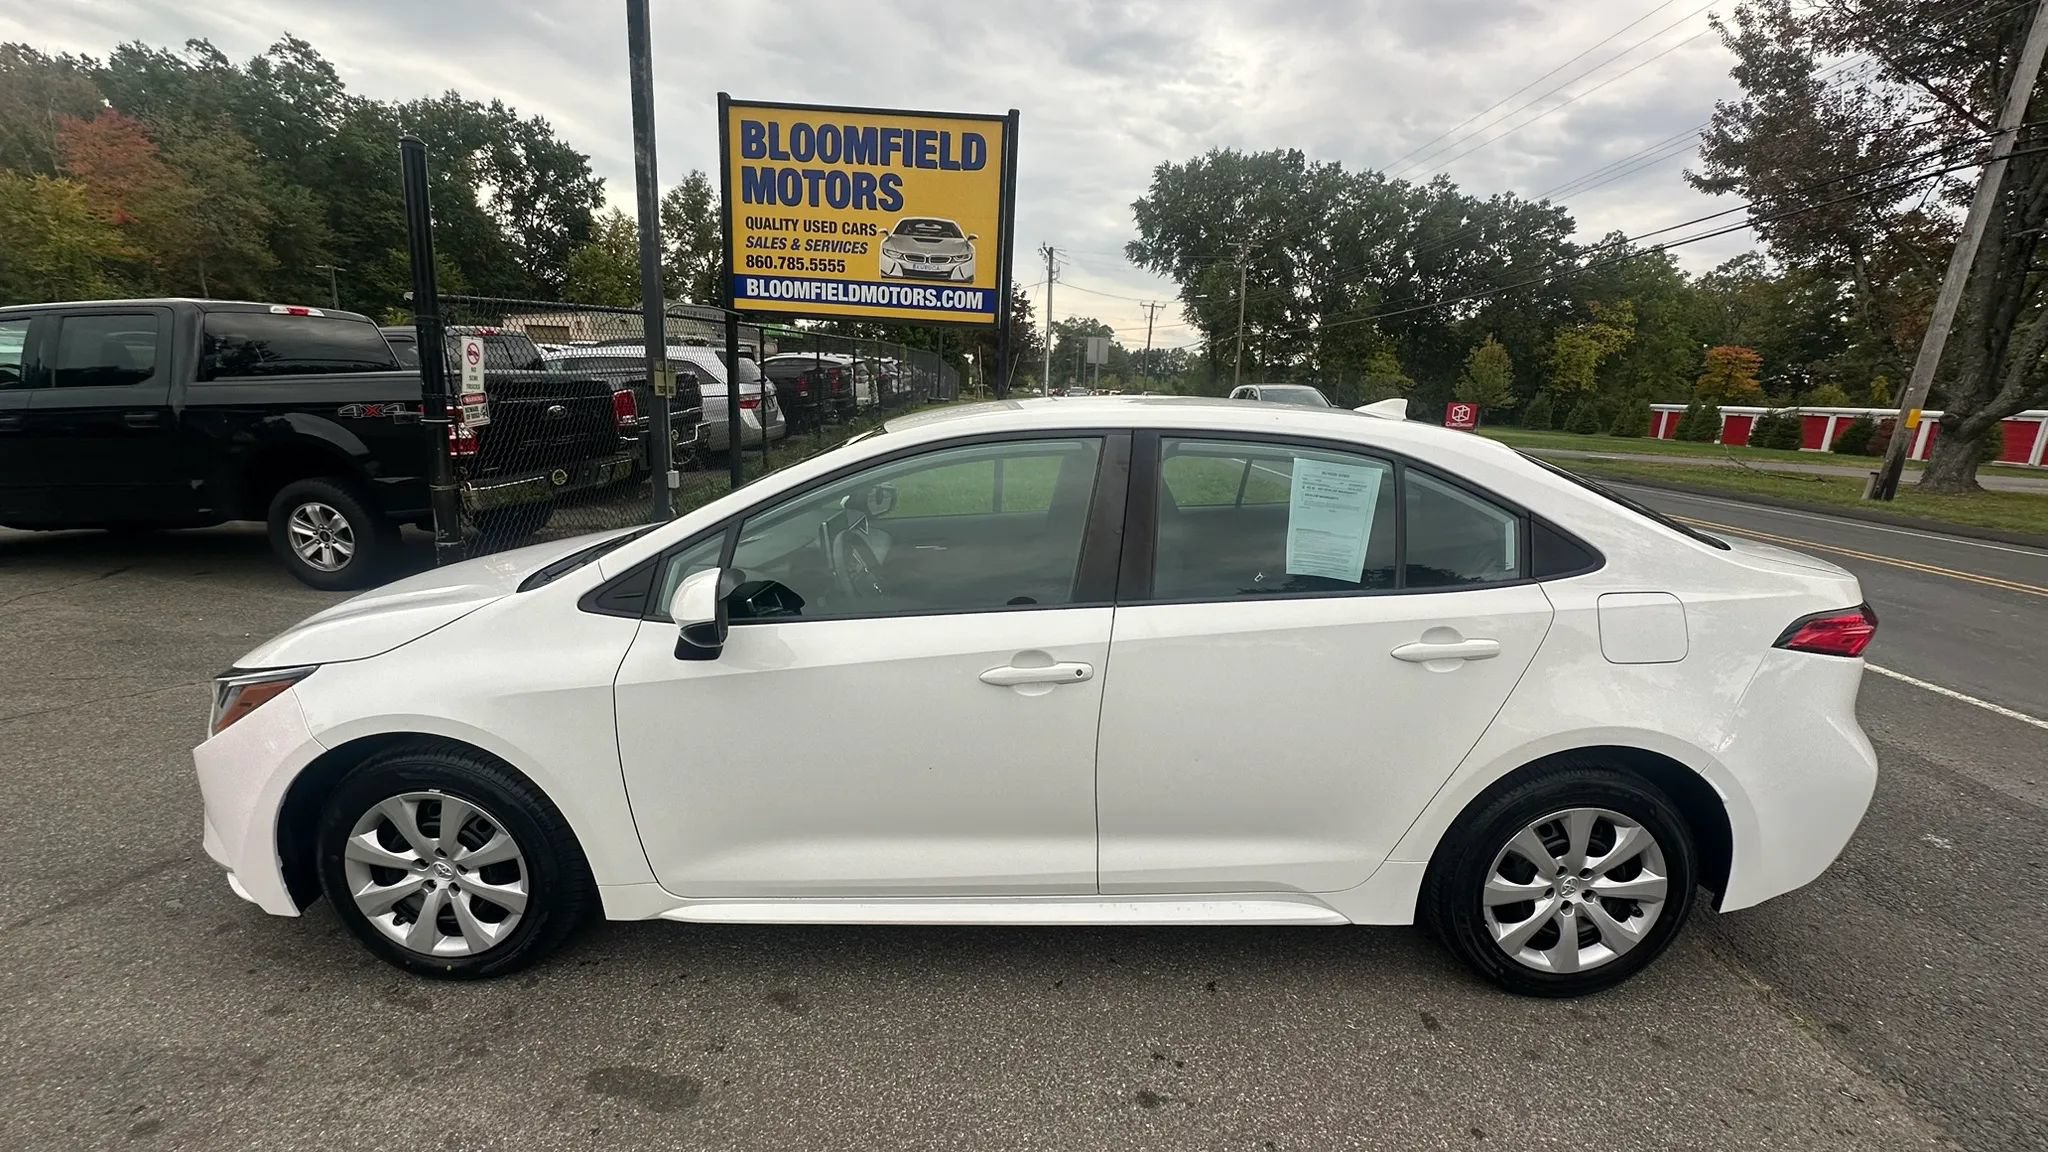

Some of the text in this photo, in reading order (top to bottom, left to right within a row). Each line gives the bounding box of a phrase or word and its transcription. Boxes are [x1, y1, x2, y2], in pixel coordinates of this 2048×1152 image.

[741, 119, 987, 171] BLOOMFIELD
[741, 166, 904, 211] MOTORS
[745, 216, 877, 237] QUALITY USED CARS
[745, 235, 869, 255] SALES & SERVICES
[745, 254, 846, 273] 860.785.5555
[746, 278, 983, 310] BLOOMFIELDMOTORS.COM
